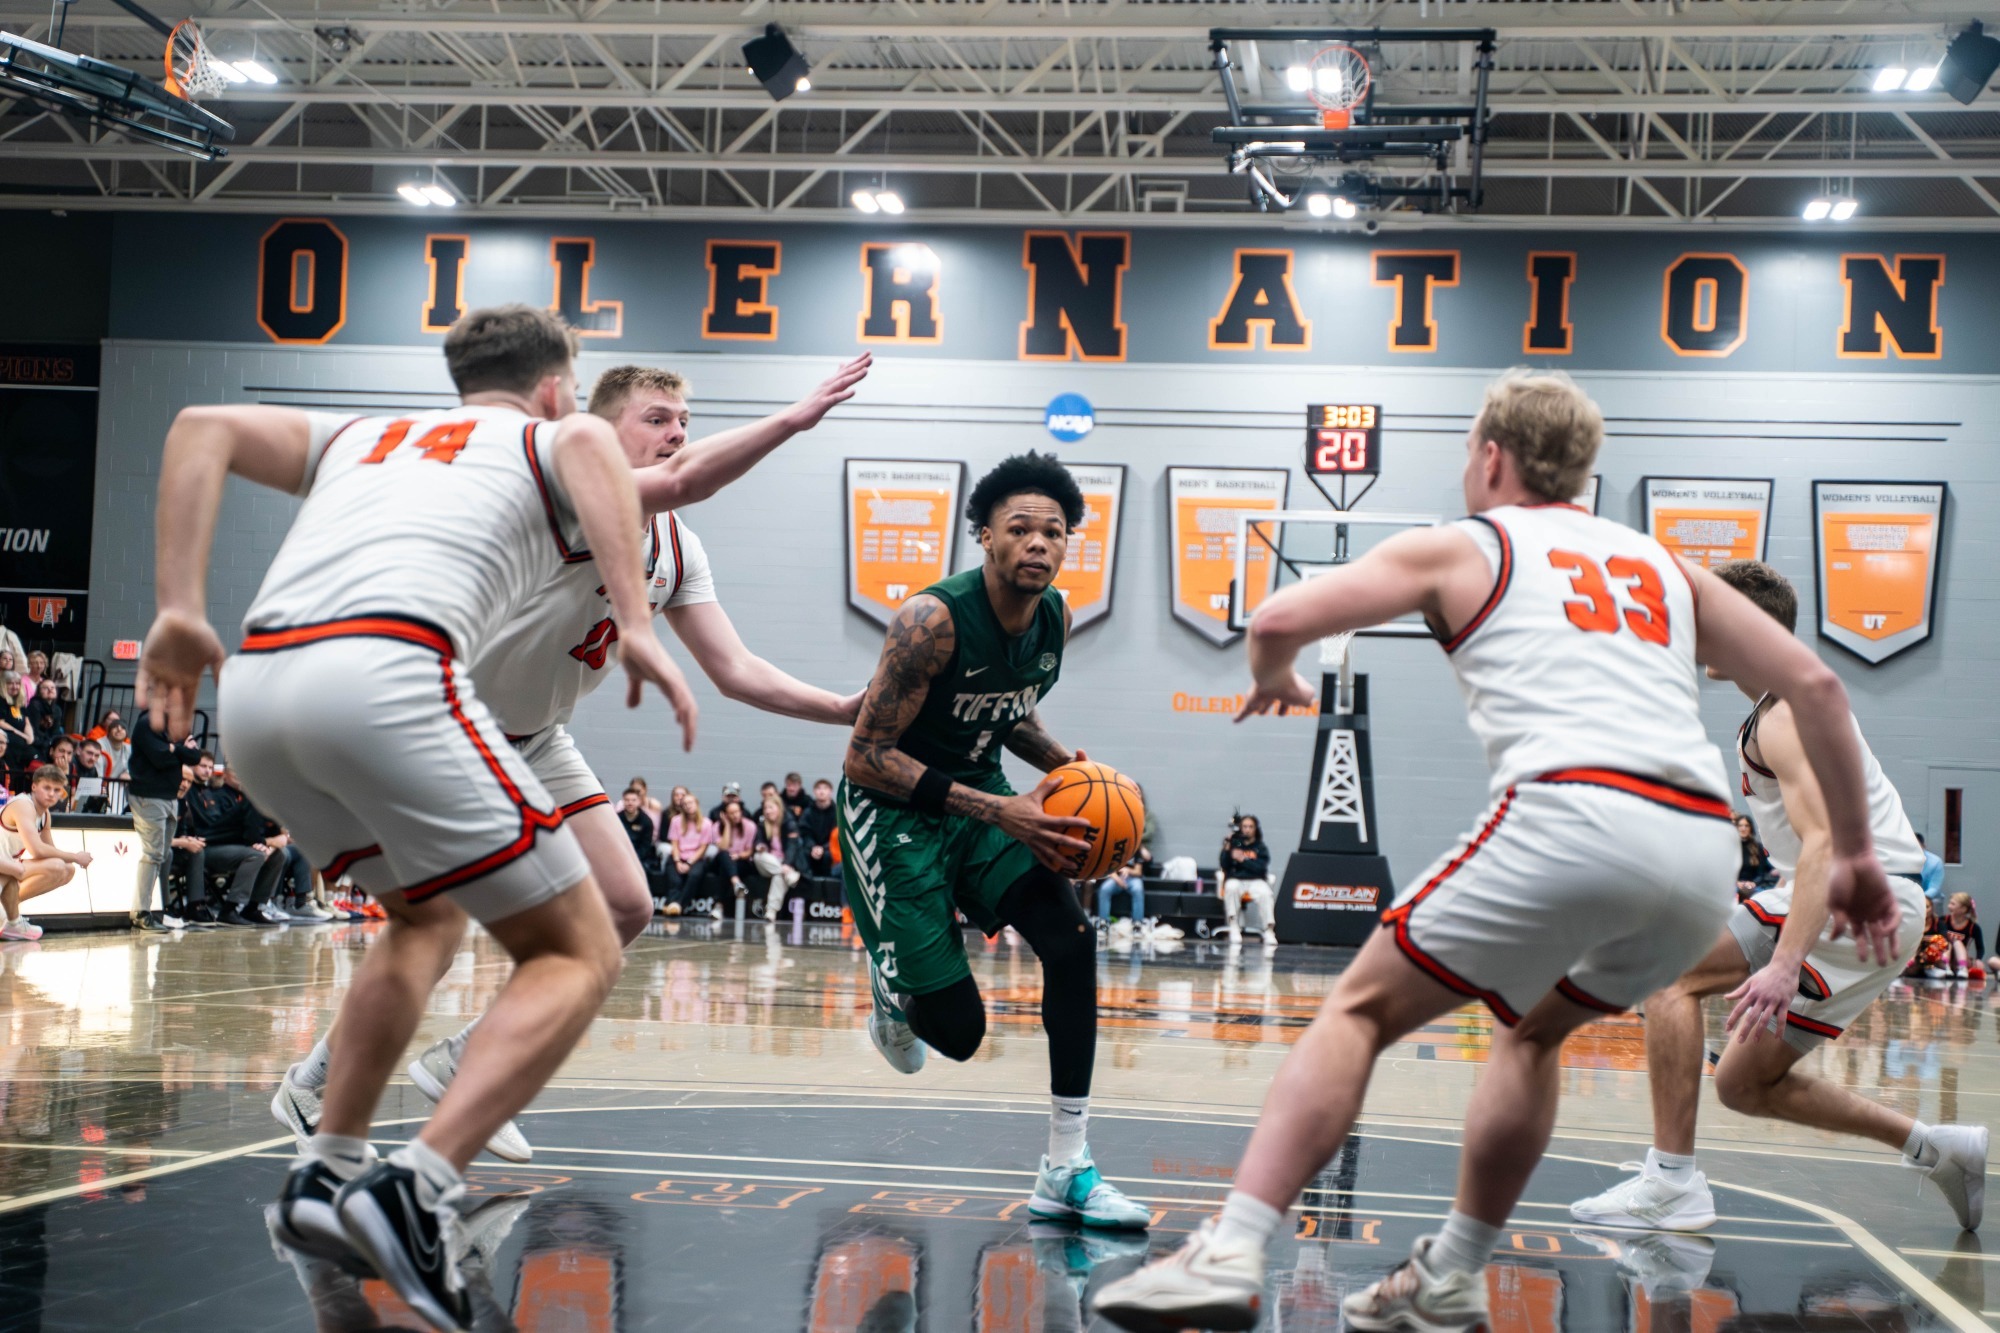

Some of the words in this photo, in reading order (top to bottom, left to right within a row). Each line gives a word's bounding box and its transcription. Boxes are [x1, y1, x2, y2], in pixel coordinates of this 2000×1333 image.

[1322, 404, 1376, 429] 3:03
[357, 418, 478, 465] 14
[1315, 430, 1367, 472] 20
[1215, 480, 1277, 489] BASKETBALL
[1652, 489, 1699, 499] WOMEN'S
[1704, 490, 1766, 501] VOLLEYBALL
[1822, 493, 1872, 502] WOMEN'S
[1875, 494, 1937, 504] VOLLEYBALL
[28, 596, 67, 624] UF
[1547, 548, 1671, 648] 33
[1863, 613, 1887, 630] UF
[952, 683, 1042, 722] TIFFIN
[1296, 883, 1378, 902] CHATELAIN
